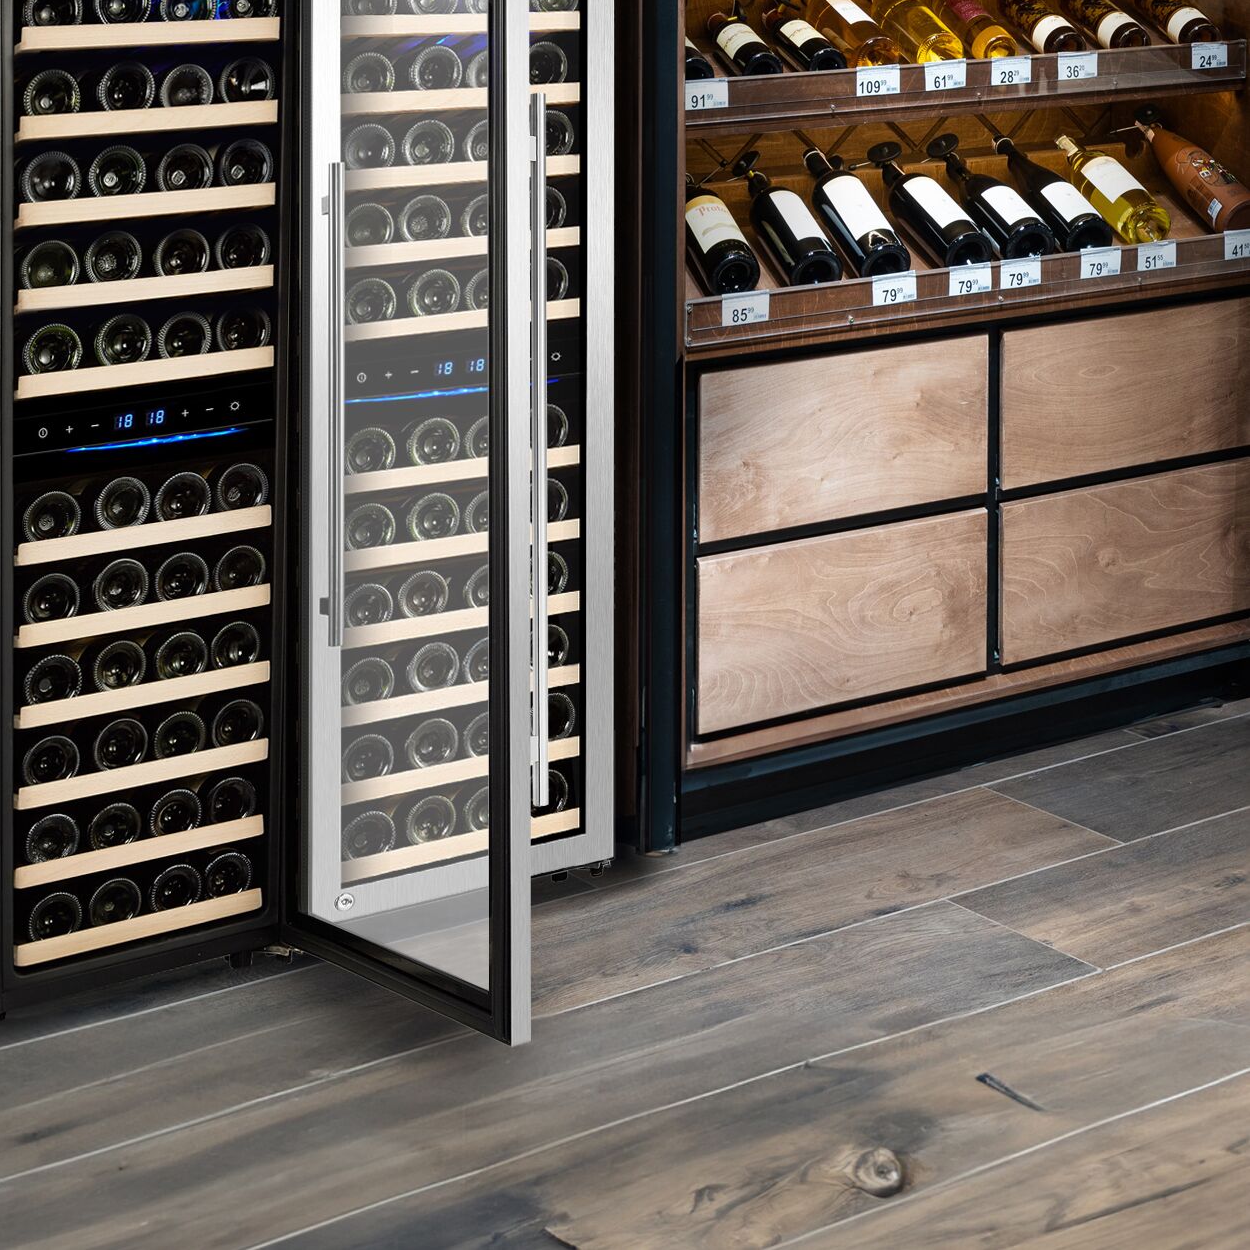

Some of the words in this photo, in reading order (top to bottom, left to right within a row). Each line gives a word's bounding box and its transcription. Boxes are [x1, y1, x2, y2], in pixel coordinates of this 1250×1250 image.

[437, 362, 453, 375] 18
[470, 359, 485, 372] 18
[118, 414, 133, 428] 18
[149, 410, 165, 424] 18
